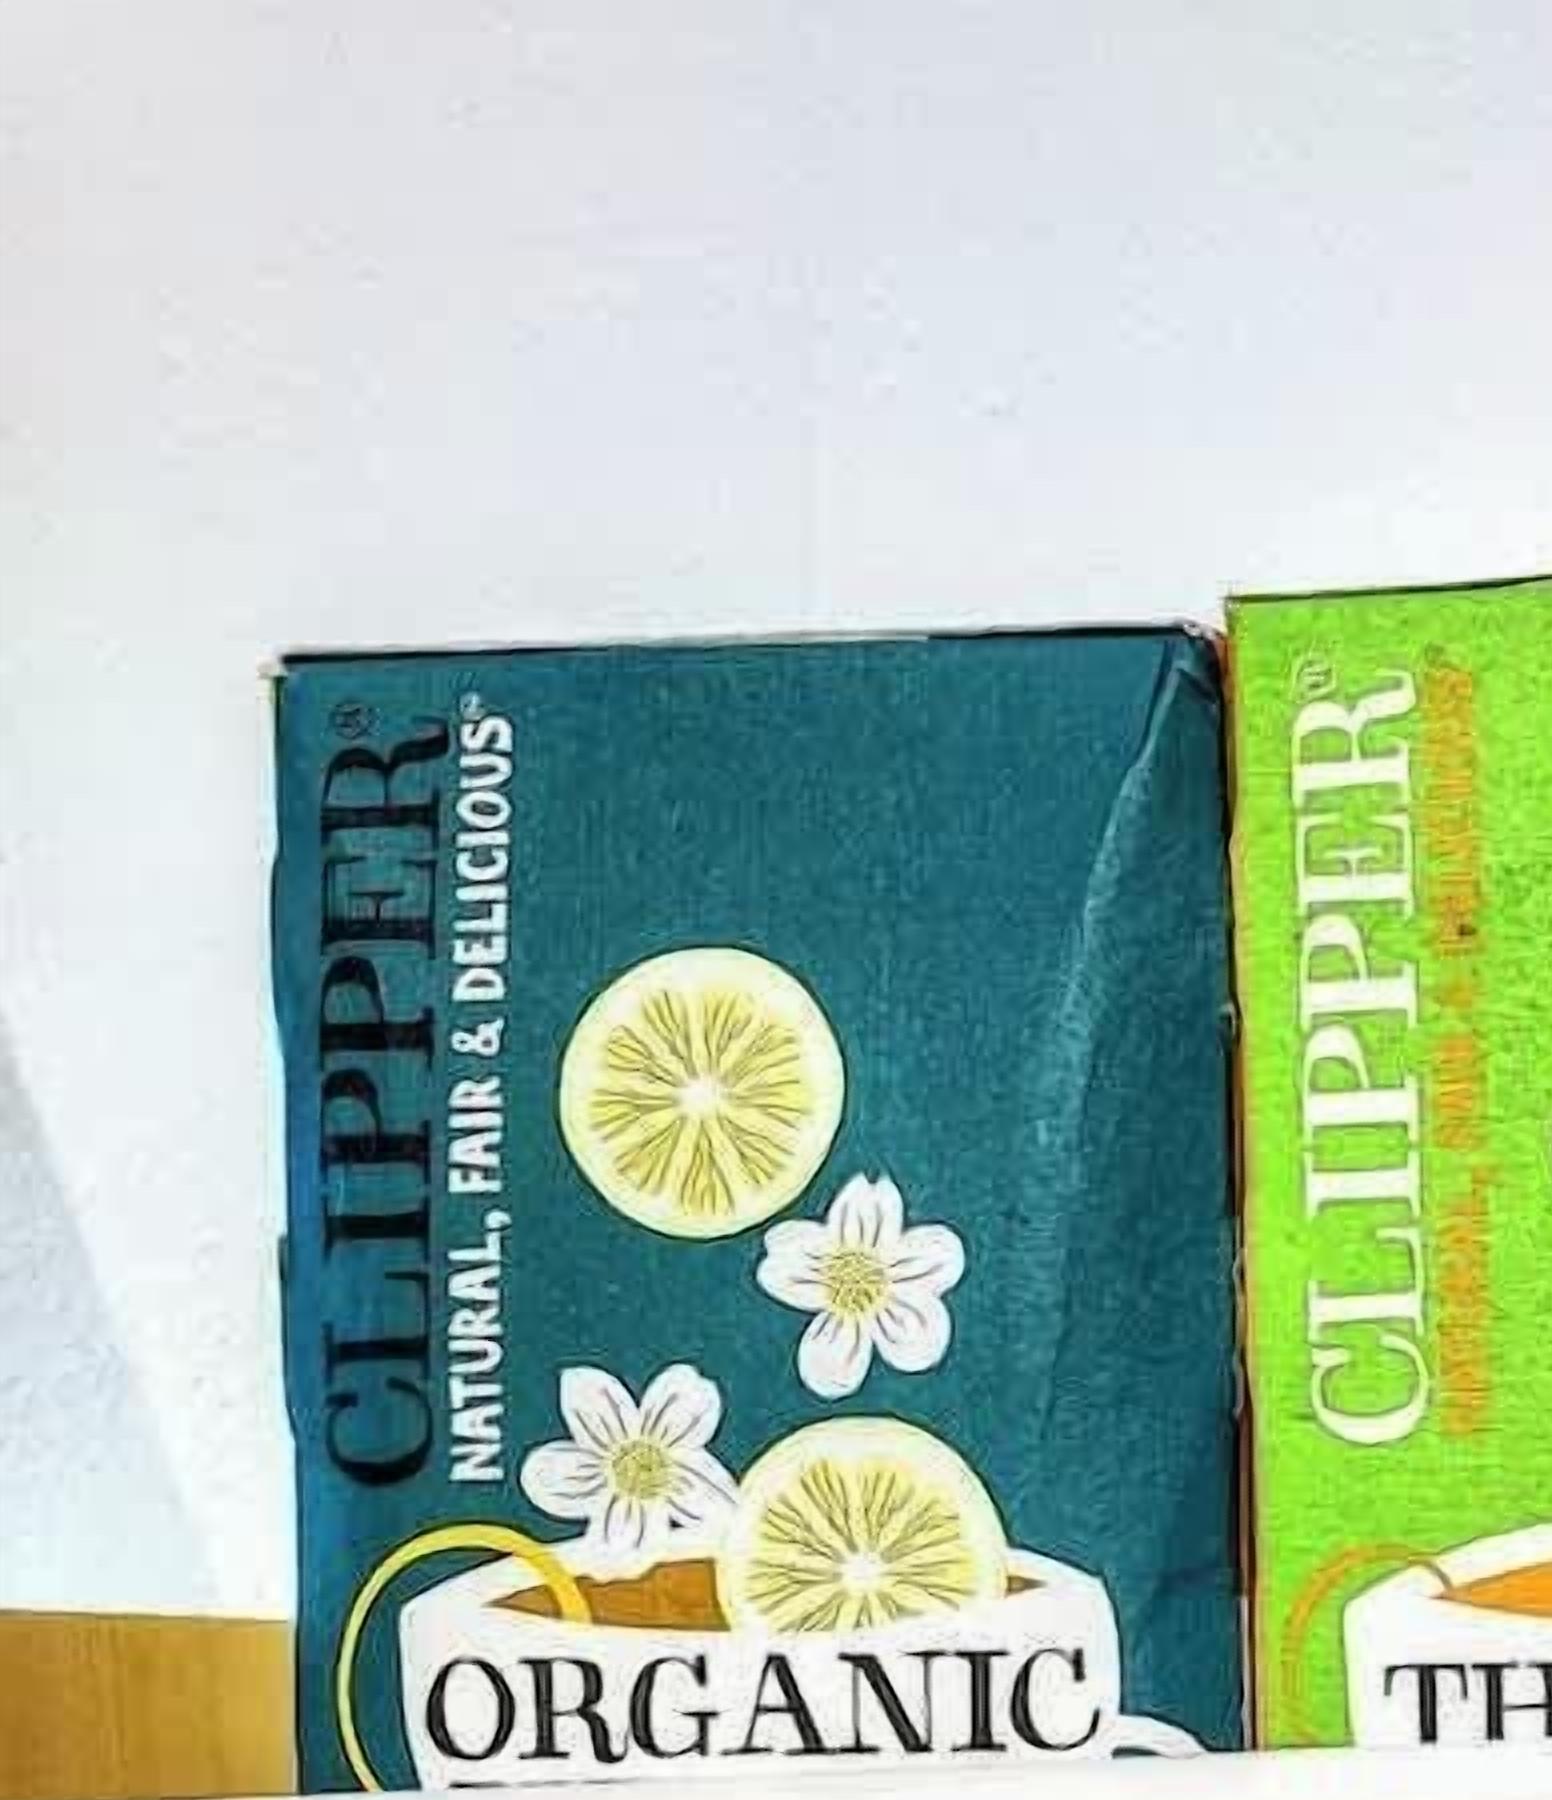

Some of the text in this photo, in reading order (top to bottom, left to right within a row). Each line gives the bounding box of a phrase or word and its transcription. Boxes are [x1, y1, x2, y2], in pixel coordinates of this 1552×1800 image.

[450, 1018, 504, 1057] &
[448, 1077, 504, 1196] FAIR
[448, 1208, 512, 1484] NATURAL,
[424, 1646, 1101, 1764] ORGANIC
